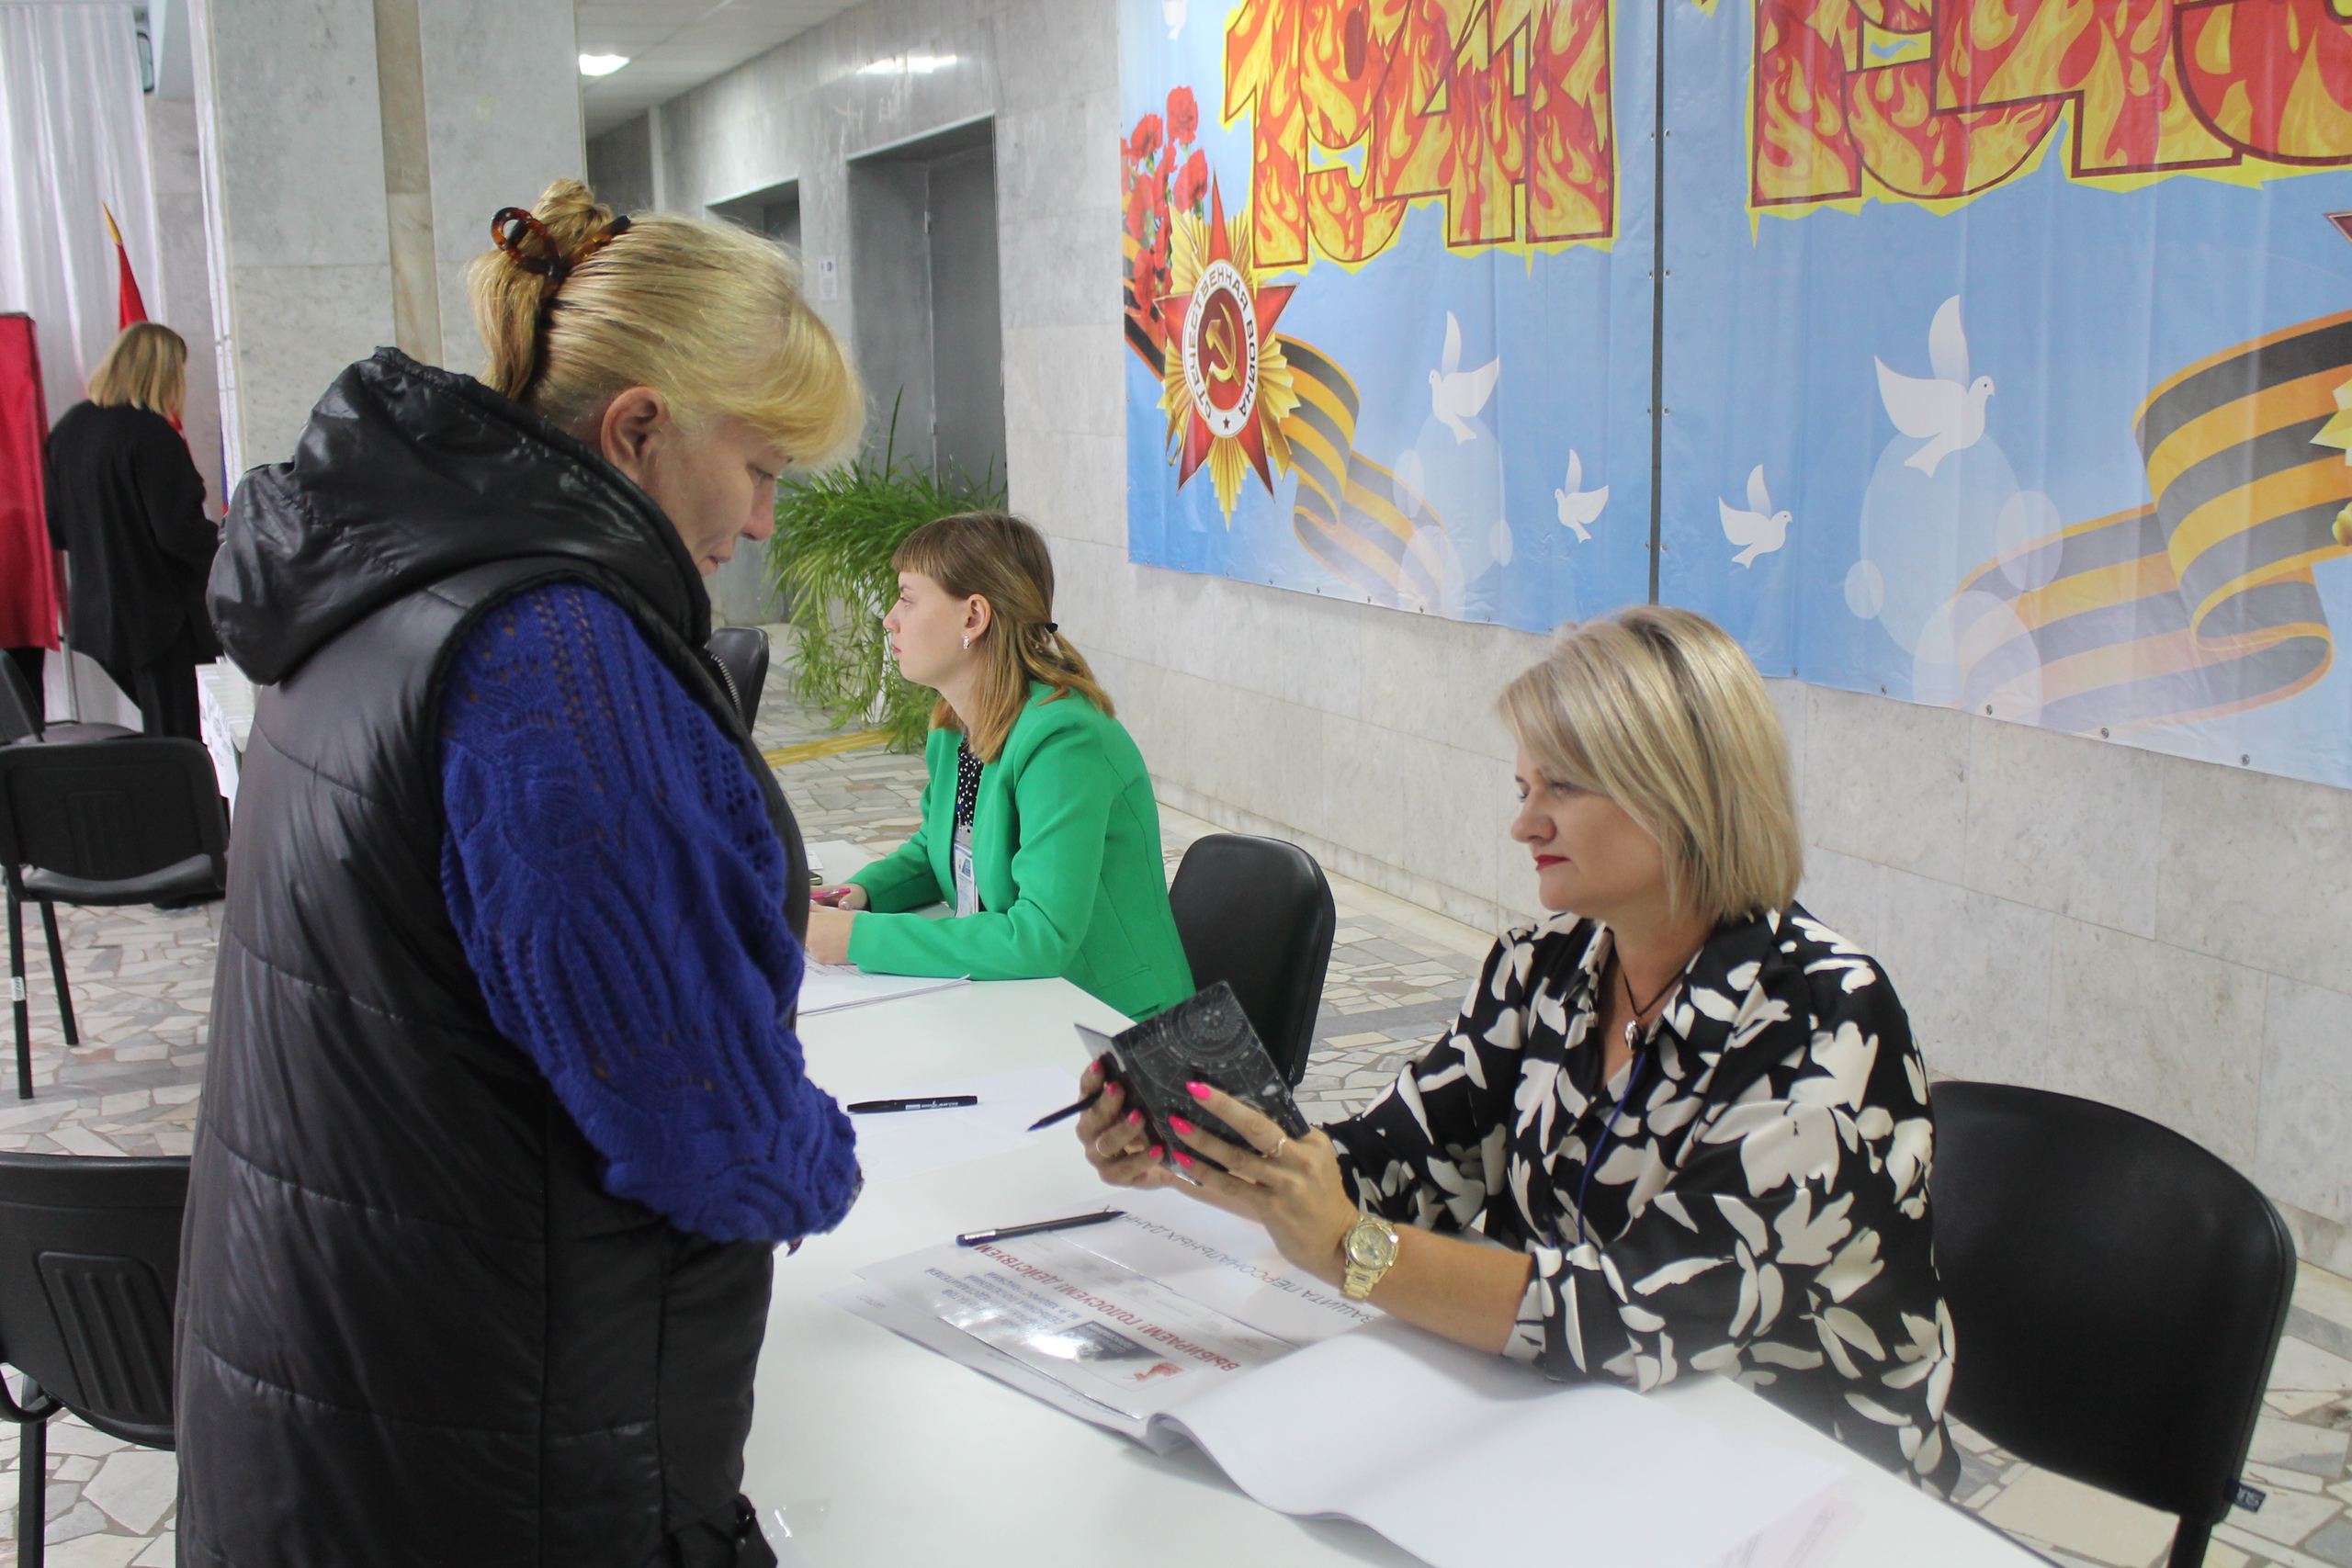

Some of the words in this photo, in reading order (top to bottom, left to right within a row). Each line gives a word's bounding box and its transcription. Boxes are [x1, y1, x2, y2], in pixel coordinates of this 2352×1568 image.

[1187, 265, 1250, 421] ОТЕЧЕСТВЕННАЯ
[1095, 1205, 1172, 1235] ДАННХ
[1157, 1232, 1308, 1293] ПЕРСОНАЛЬНЫХ
[1051, 1284, 1146, 1325] ГОЛОСУЕМ!
[1296, 1290, 1380, 1324] ЗАЩИТА
[1135, 1324, 1242, 1372] ВЫБИРАЕМ!
